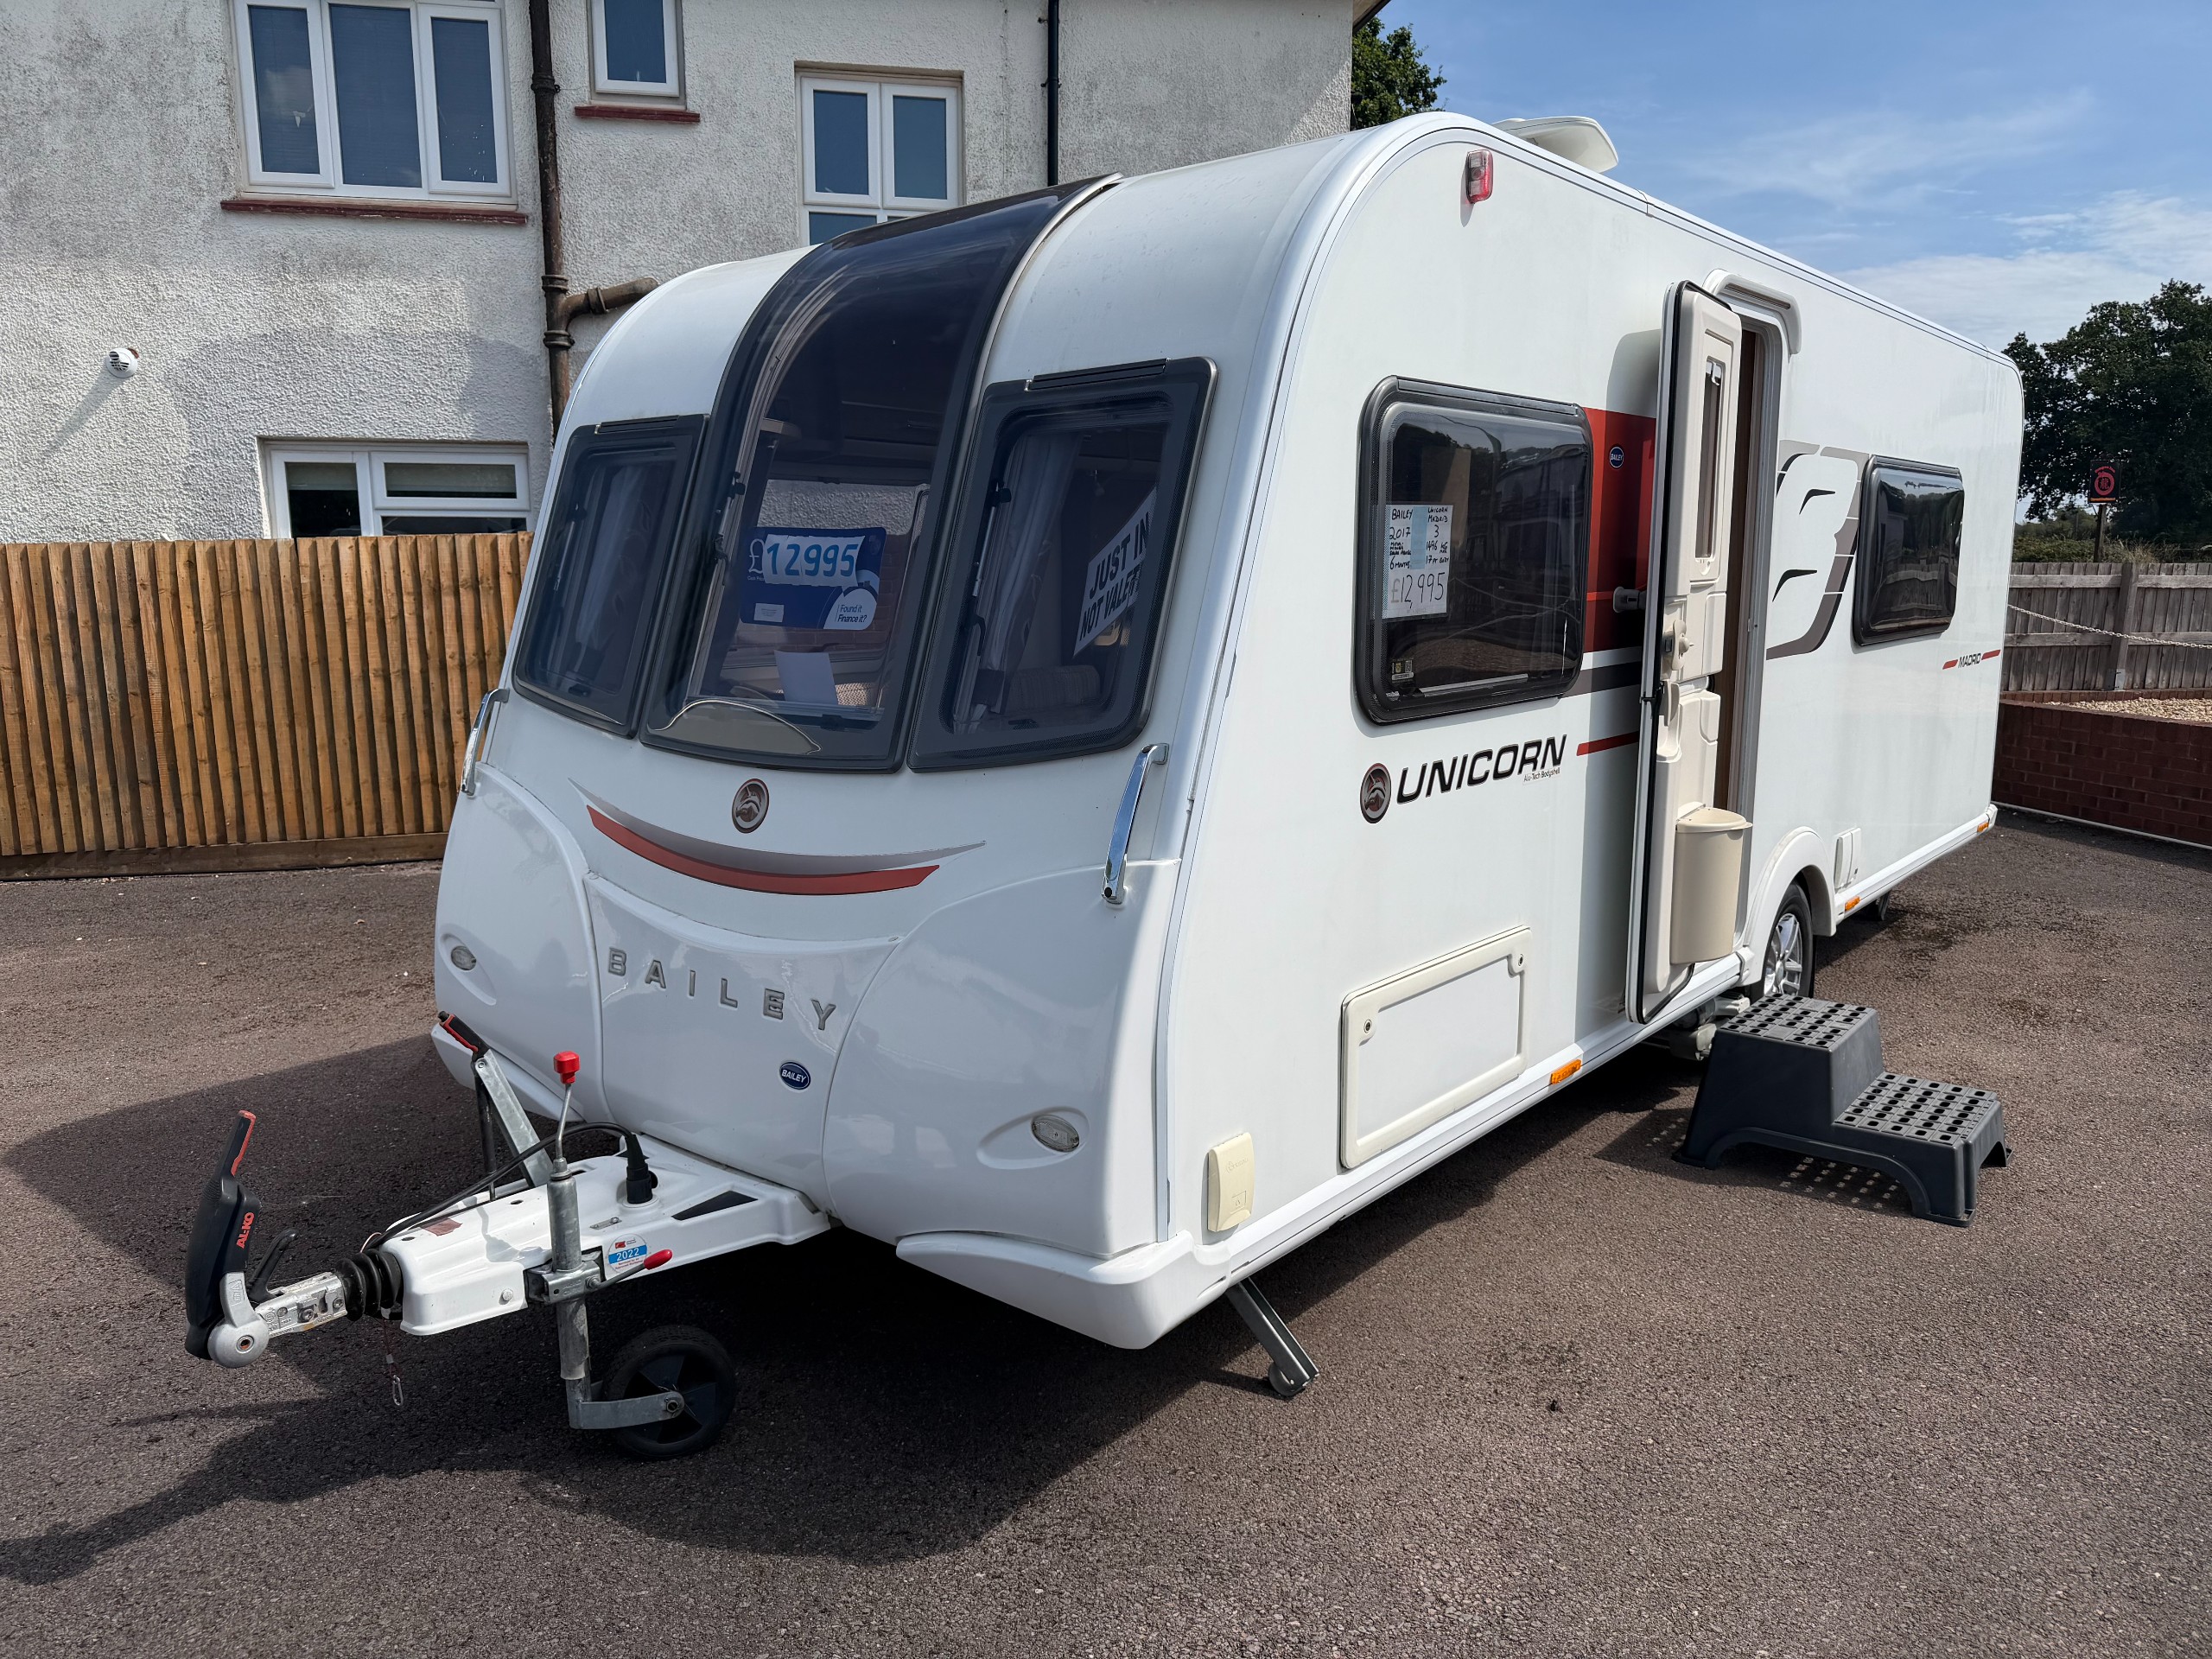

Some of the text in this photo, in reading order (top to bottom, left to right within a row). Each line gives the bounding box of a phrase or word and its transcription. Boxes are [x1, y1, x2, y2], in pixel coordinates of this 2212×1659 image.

[1391, 508, 1413, 520] BAILEY
[1389, 526, 1411, 540] 2017
[1433, 524, 1440, 538] 3
[1089, 512, 1149, 600] JUST IN
[840, 604, 856, 613] Found
[1079, 563, 1141, 641] NOT VALET
[858, 614, 867, 623] it?
[1958, 652, 1981, 669] MADRID
[1396, 734, 1567, 804] UNICORN
[607, 946, 837, 1031] BAILEY
[781, 1068, 807, 1084] BAILEY
[616, 1247, 640, 1262] 2022
